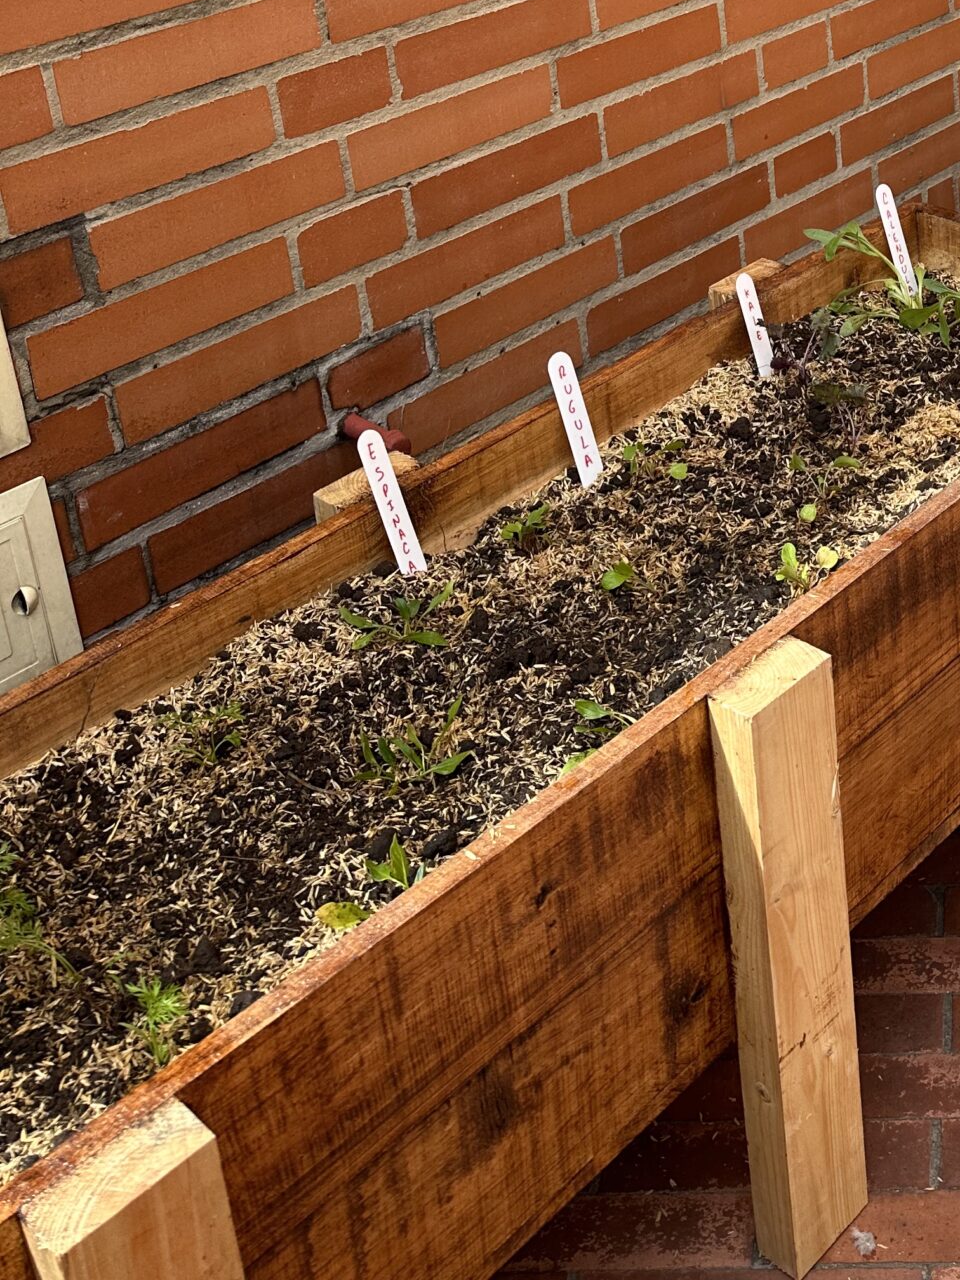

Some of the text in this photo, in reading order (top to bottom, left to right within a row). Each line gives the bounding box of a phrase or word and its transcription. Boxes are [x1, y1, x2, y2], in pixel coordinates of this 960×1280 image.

[882, 191, 914, 293] CALENDULA
[743, 288, 762, 341] KALE
[558, 365, 593, 468] RUGULA
[367, 442, 417, 571] ESPINACA
